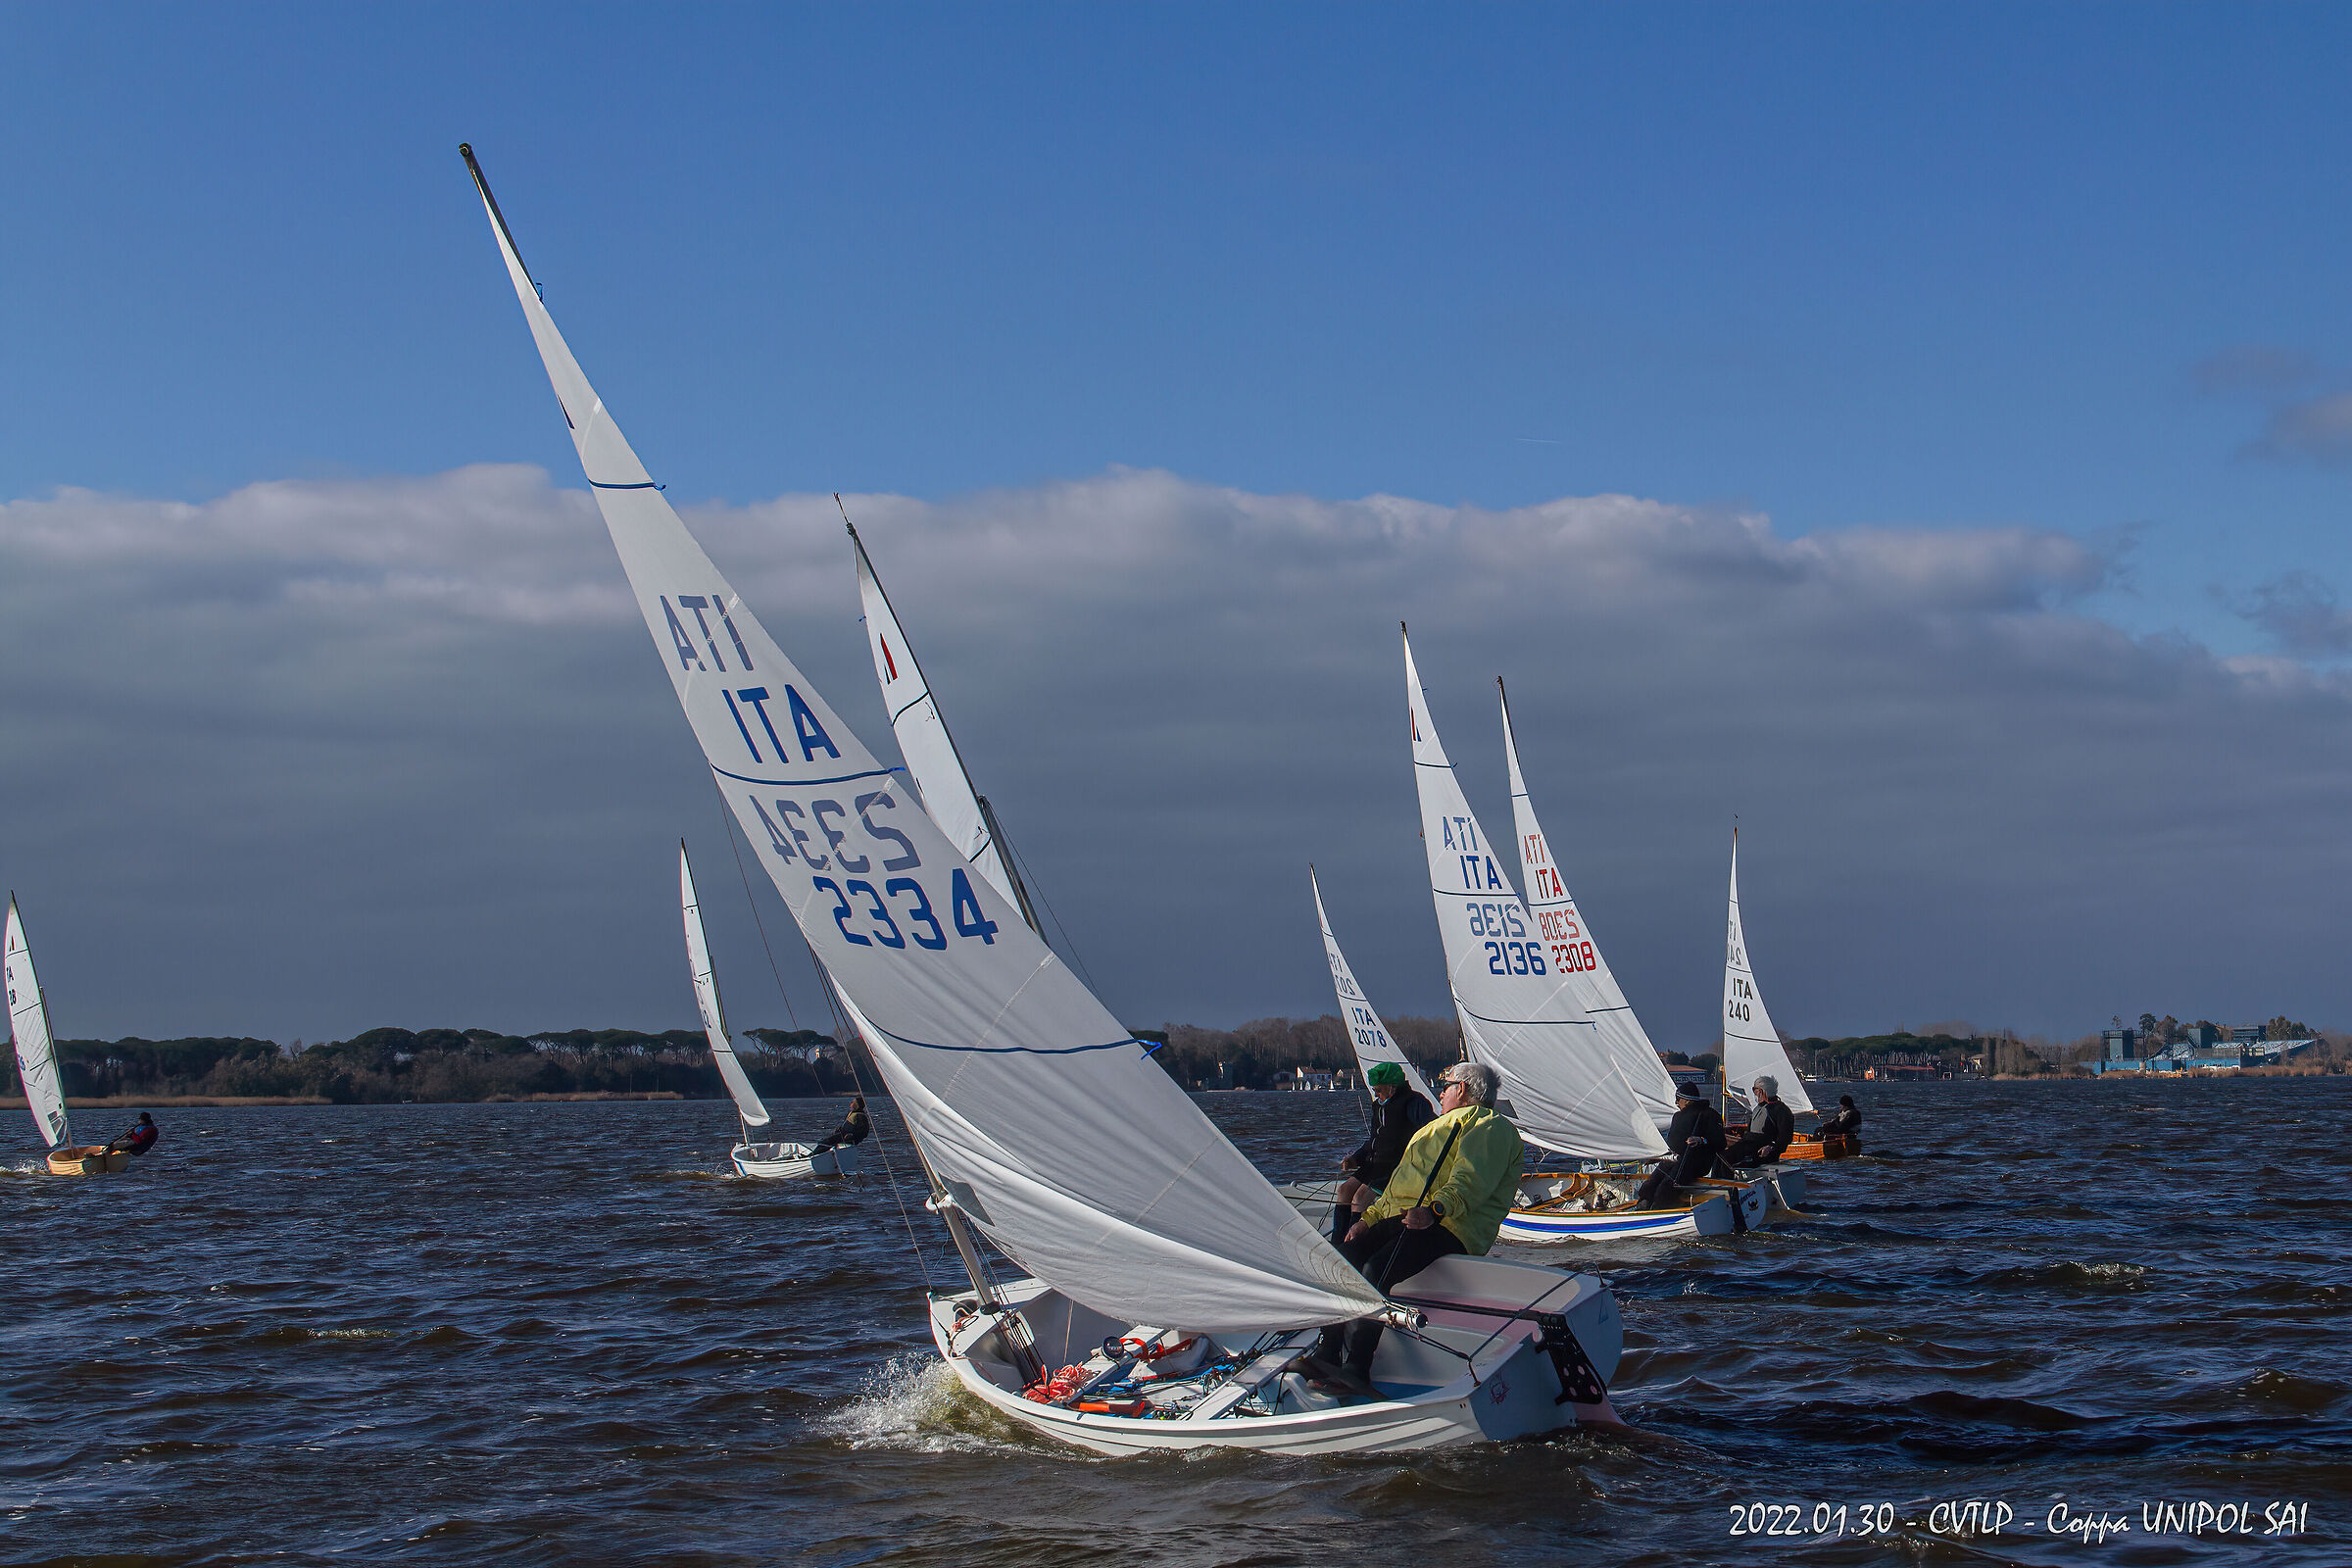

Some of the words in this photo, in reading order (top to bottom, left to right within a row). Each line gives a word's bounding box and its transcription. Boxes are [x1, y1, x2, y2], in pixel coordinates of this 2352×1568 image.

[721, 684, 842, 763] ITA
[1460, 856, 1502, 890] ITA
[1536, 867, 1563, 899] ITA
[812, 868, 999, 951] 2334
[1485, 942, 1546, 975] 2136
[1551, 941, 1596, 973] 2308
[1733, 978, 1753, 1000] ITA
[1351, 1006, 1376, 1026] ITA
[1729, 1000, 1750, 1022] 240
[1354, 1027, 1387, 1048] 2078
